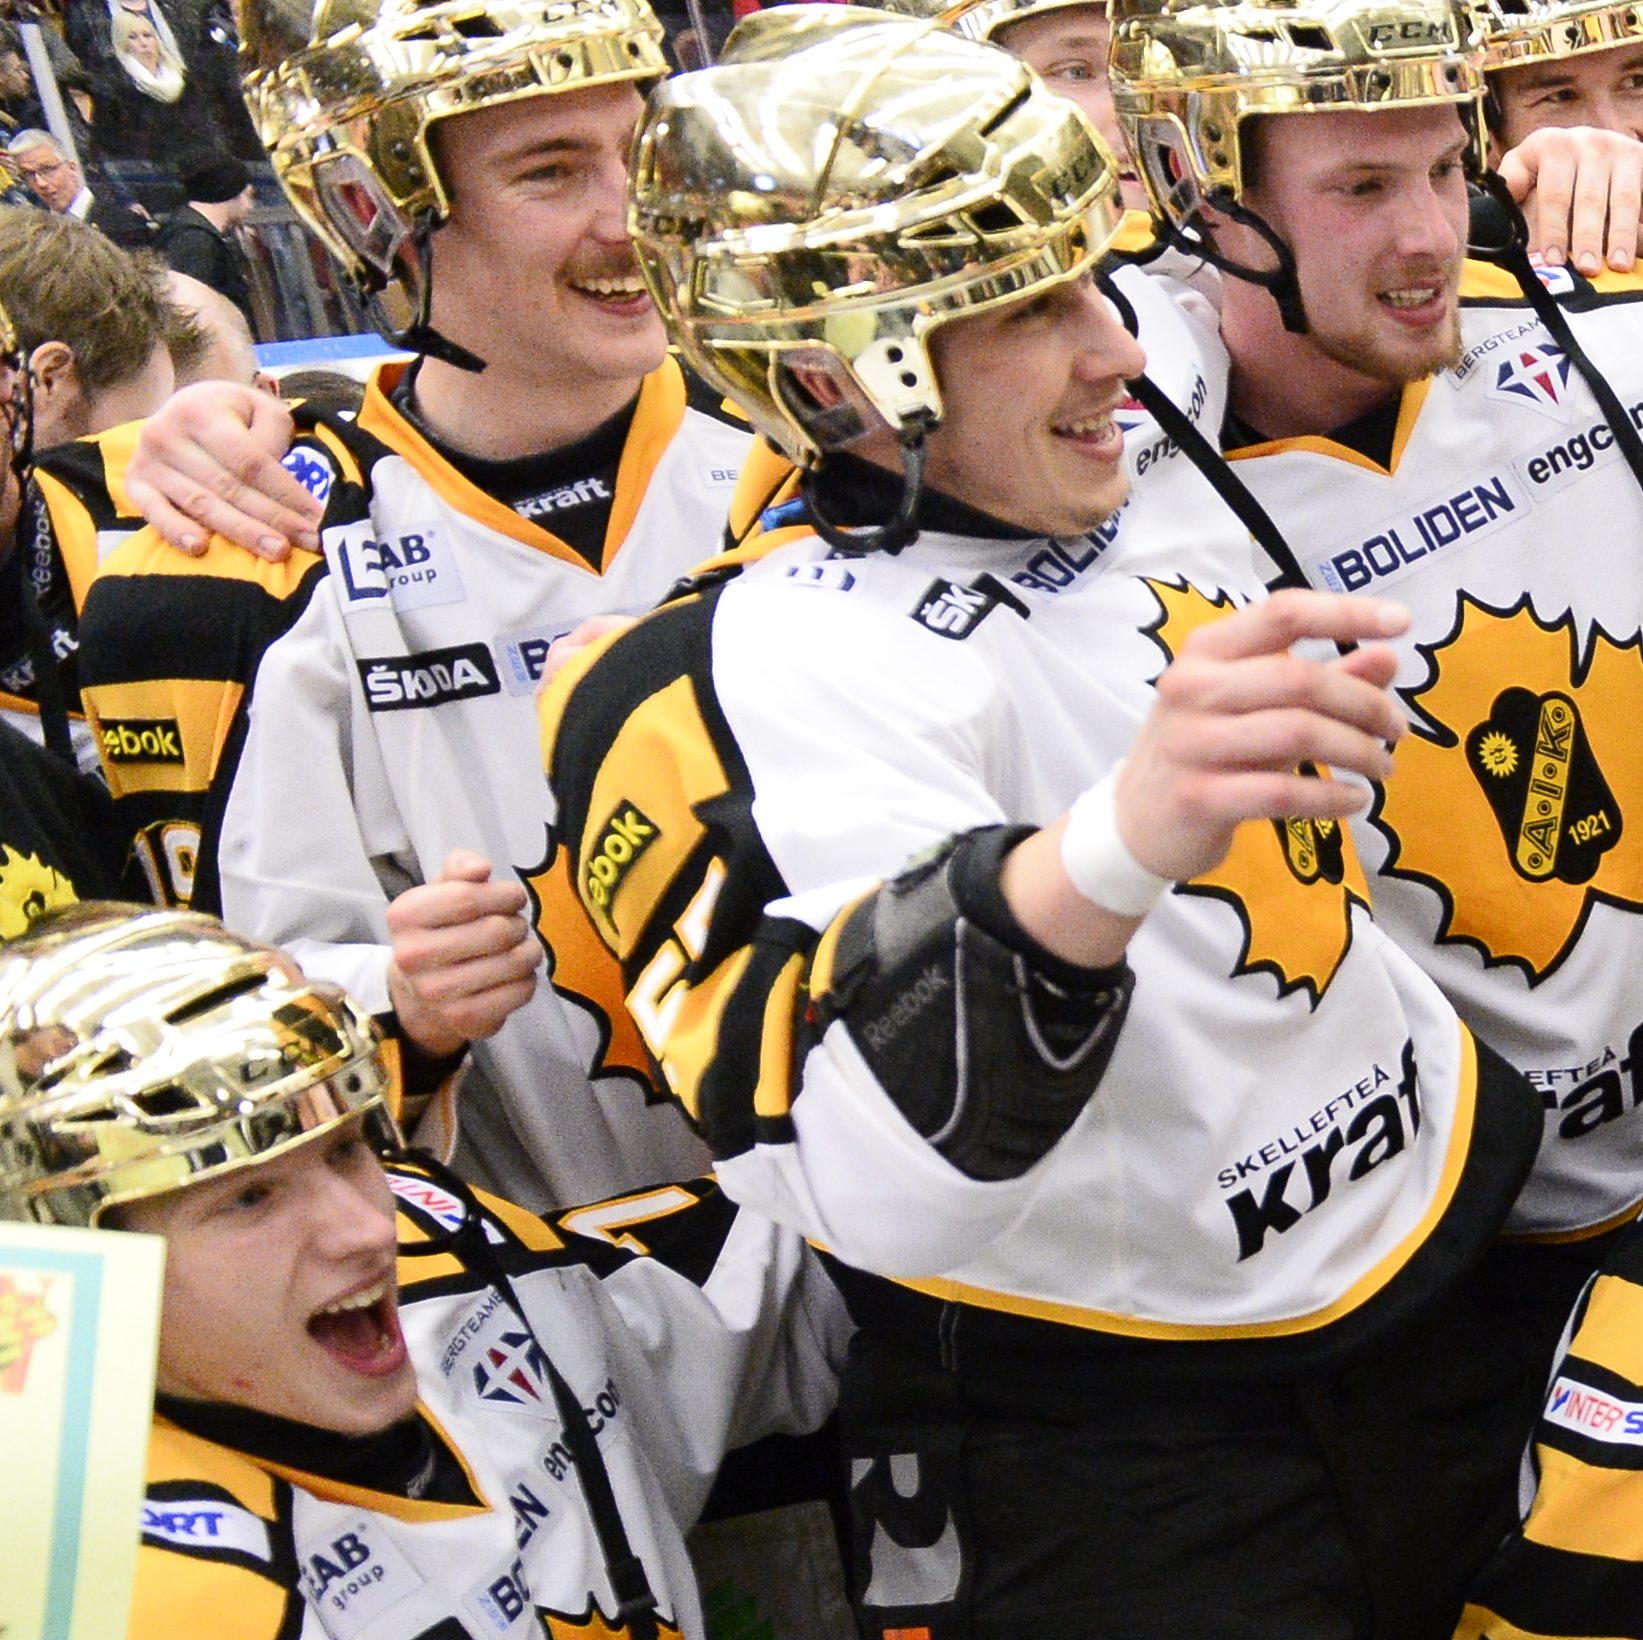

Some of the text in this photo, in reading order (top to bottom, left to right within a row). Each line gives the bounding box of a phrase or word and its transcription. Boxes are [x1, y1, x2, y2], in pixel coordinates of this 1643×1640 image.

[1369, 21, 1449, 43] CCM
[513, 478, 610, 520] kraft
[1330, 475, 1516, 594] BOLIDEN
[390, 567, 438, 589] roup
[1567, 808, 1612, 848] 1921
[1217, 1062, 1392, 1191] SKELLEFTEÅ
[330, 1563, 387, 1612] group
